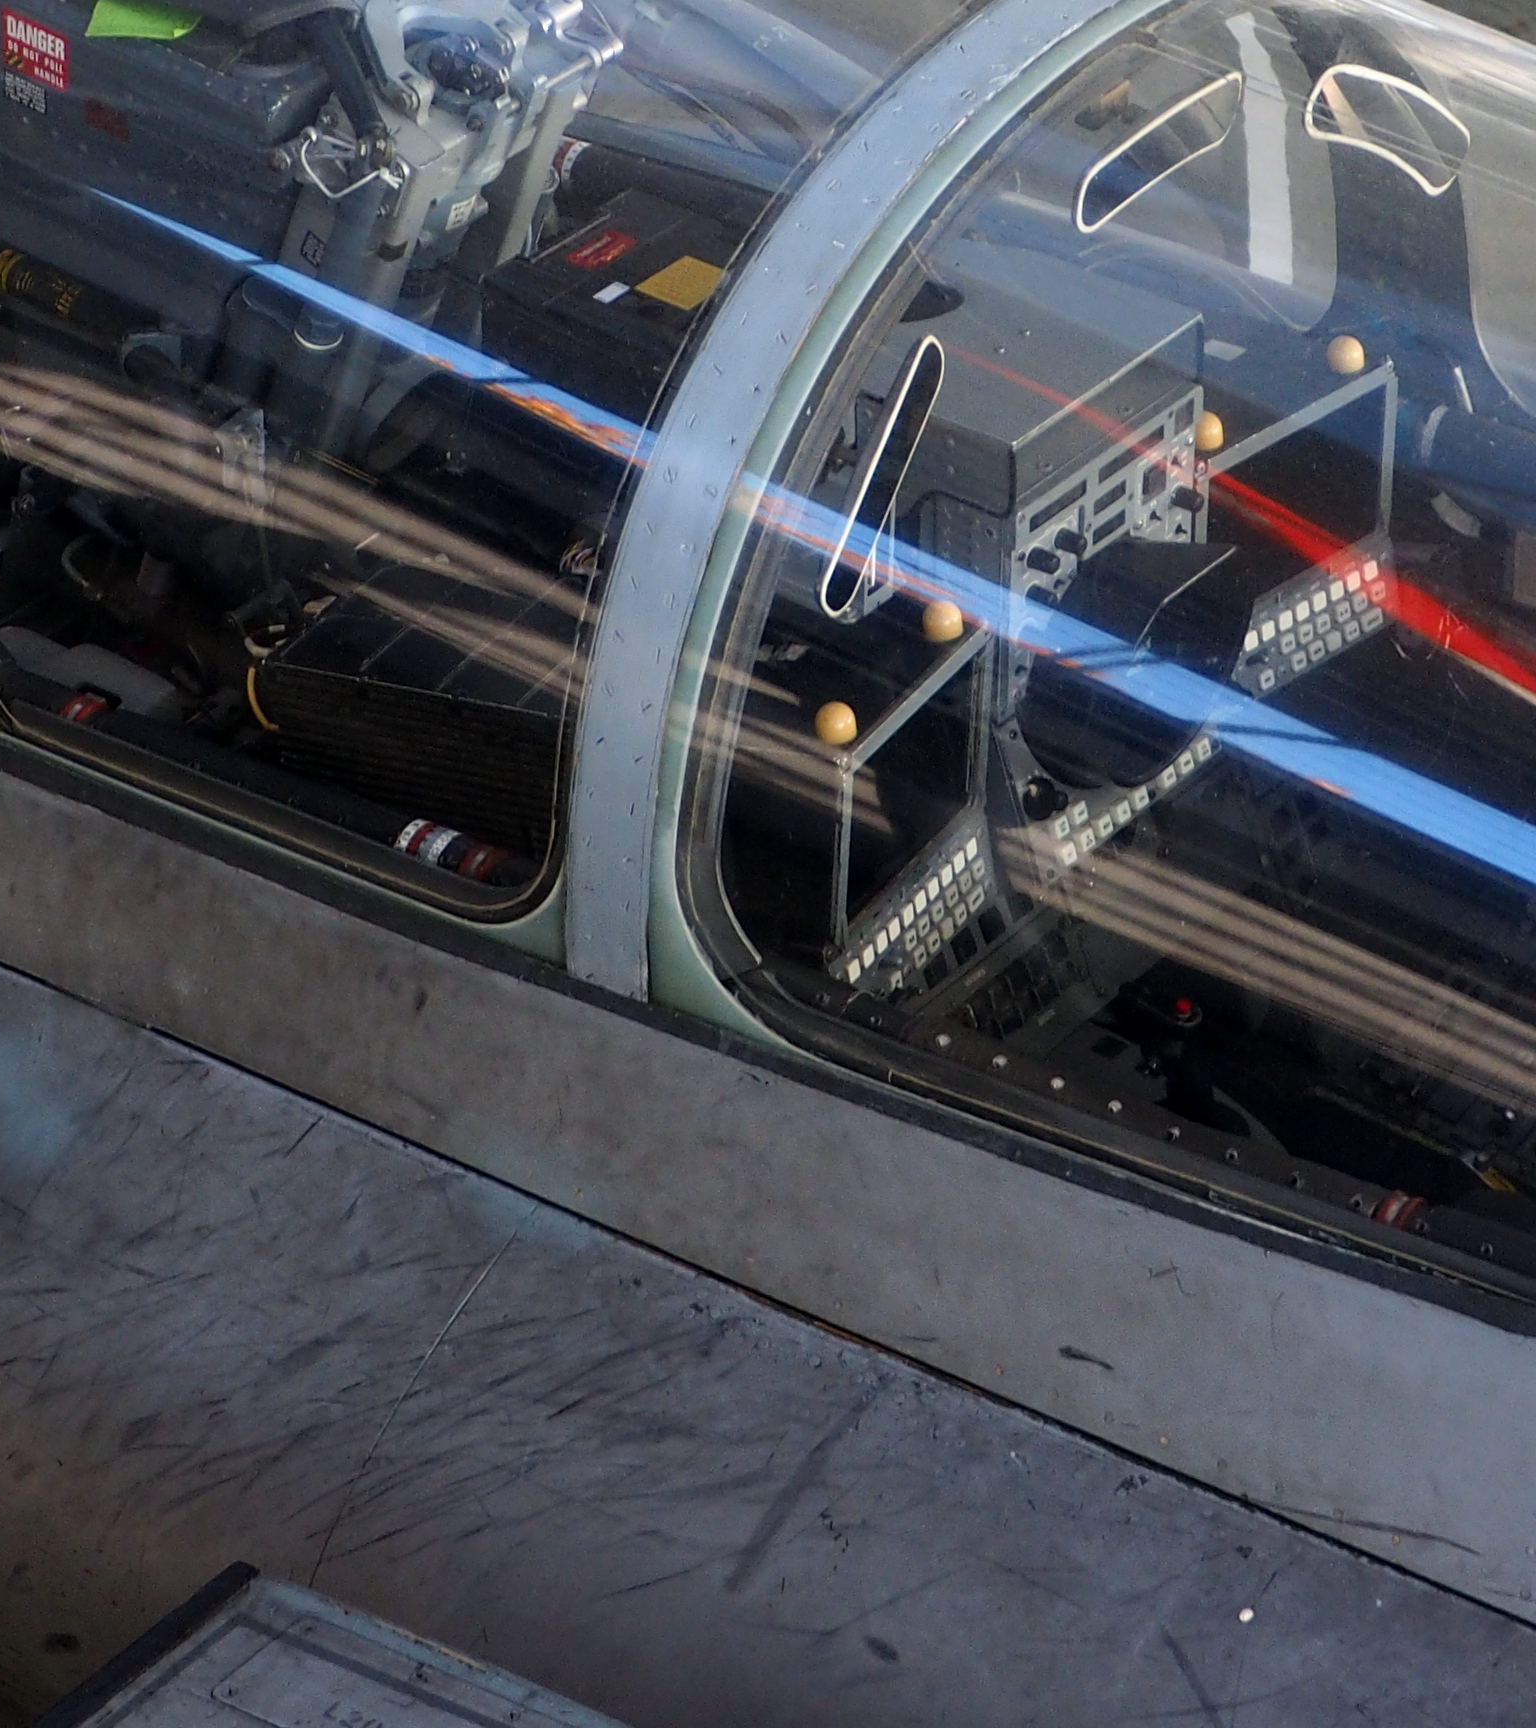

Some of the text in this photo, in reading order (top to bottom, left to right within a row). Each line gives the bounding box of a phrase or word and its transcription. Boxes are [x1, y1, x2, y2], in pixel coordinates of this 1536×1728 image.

[6, 14, 65, 61] DANGER
[7, 40, 64, 74] DO NOT PULL
[33, 67, 64, 88] HANDLE
